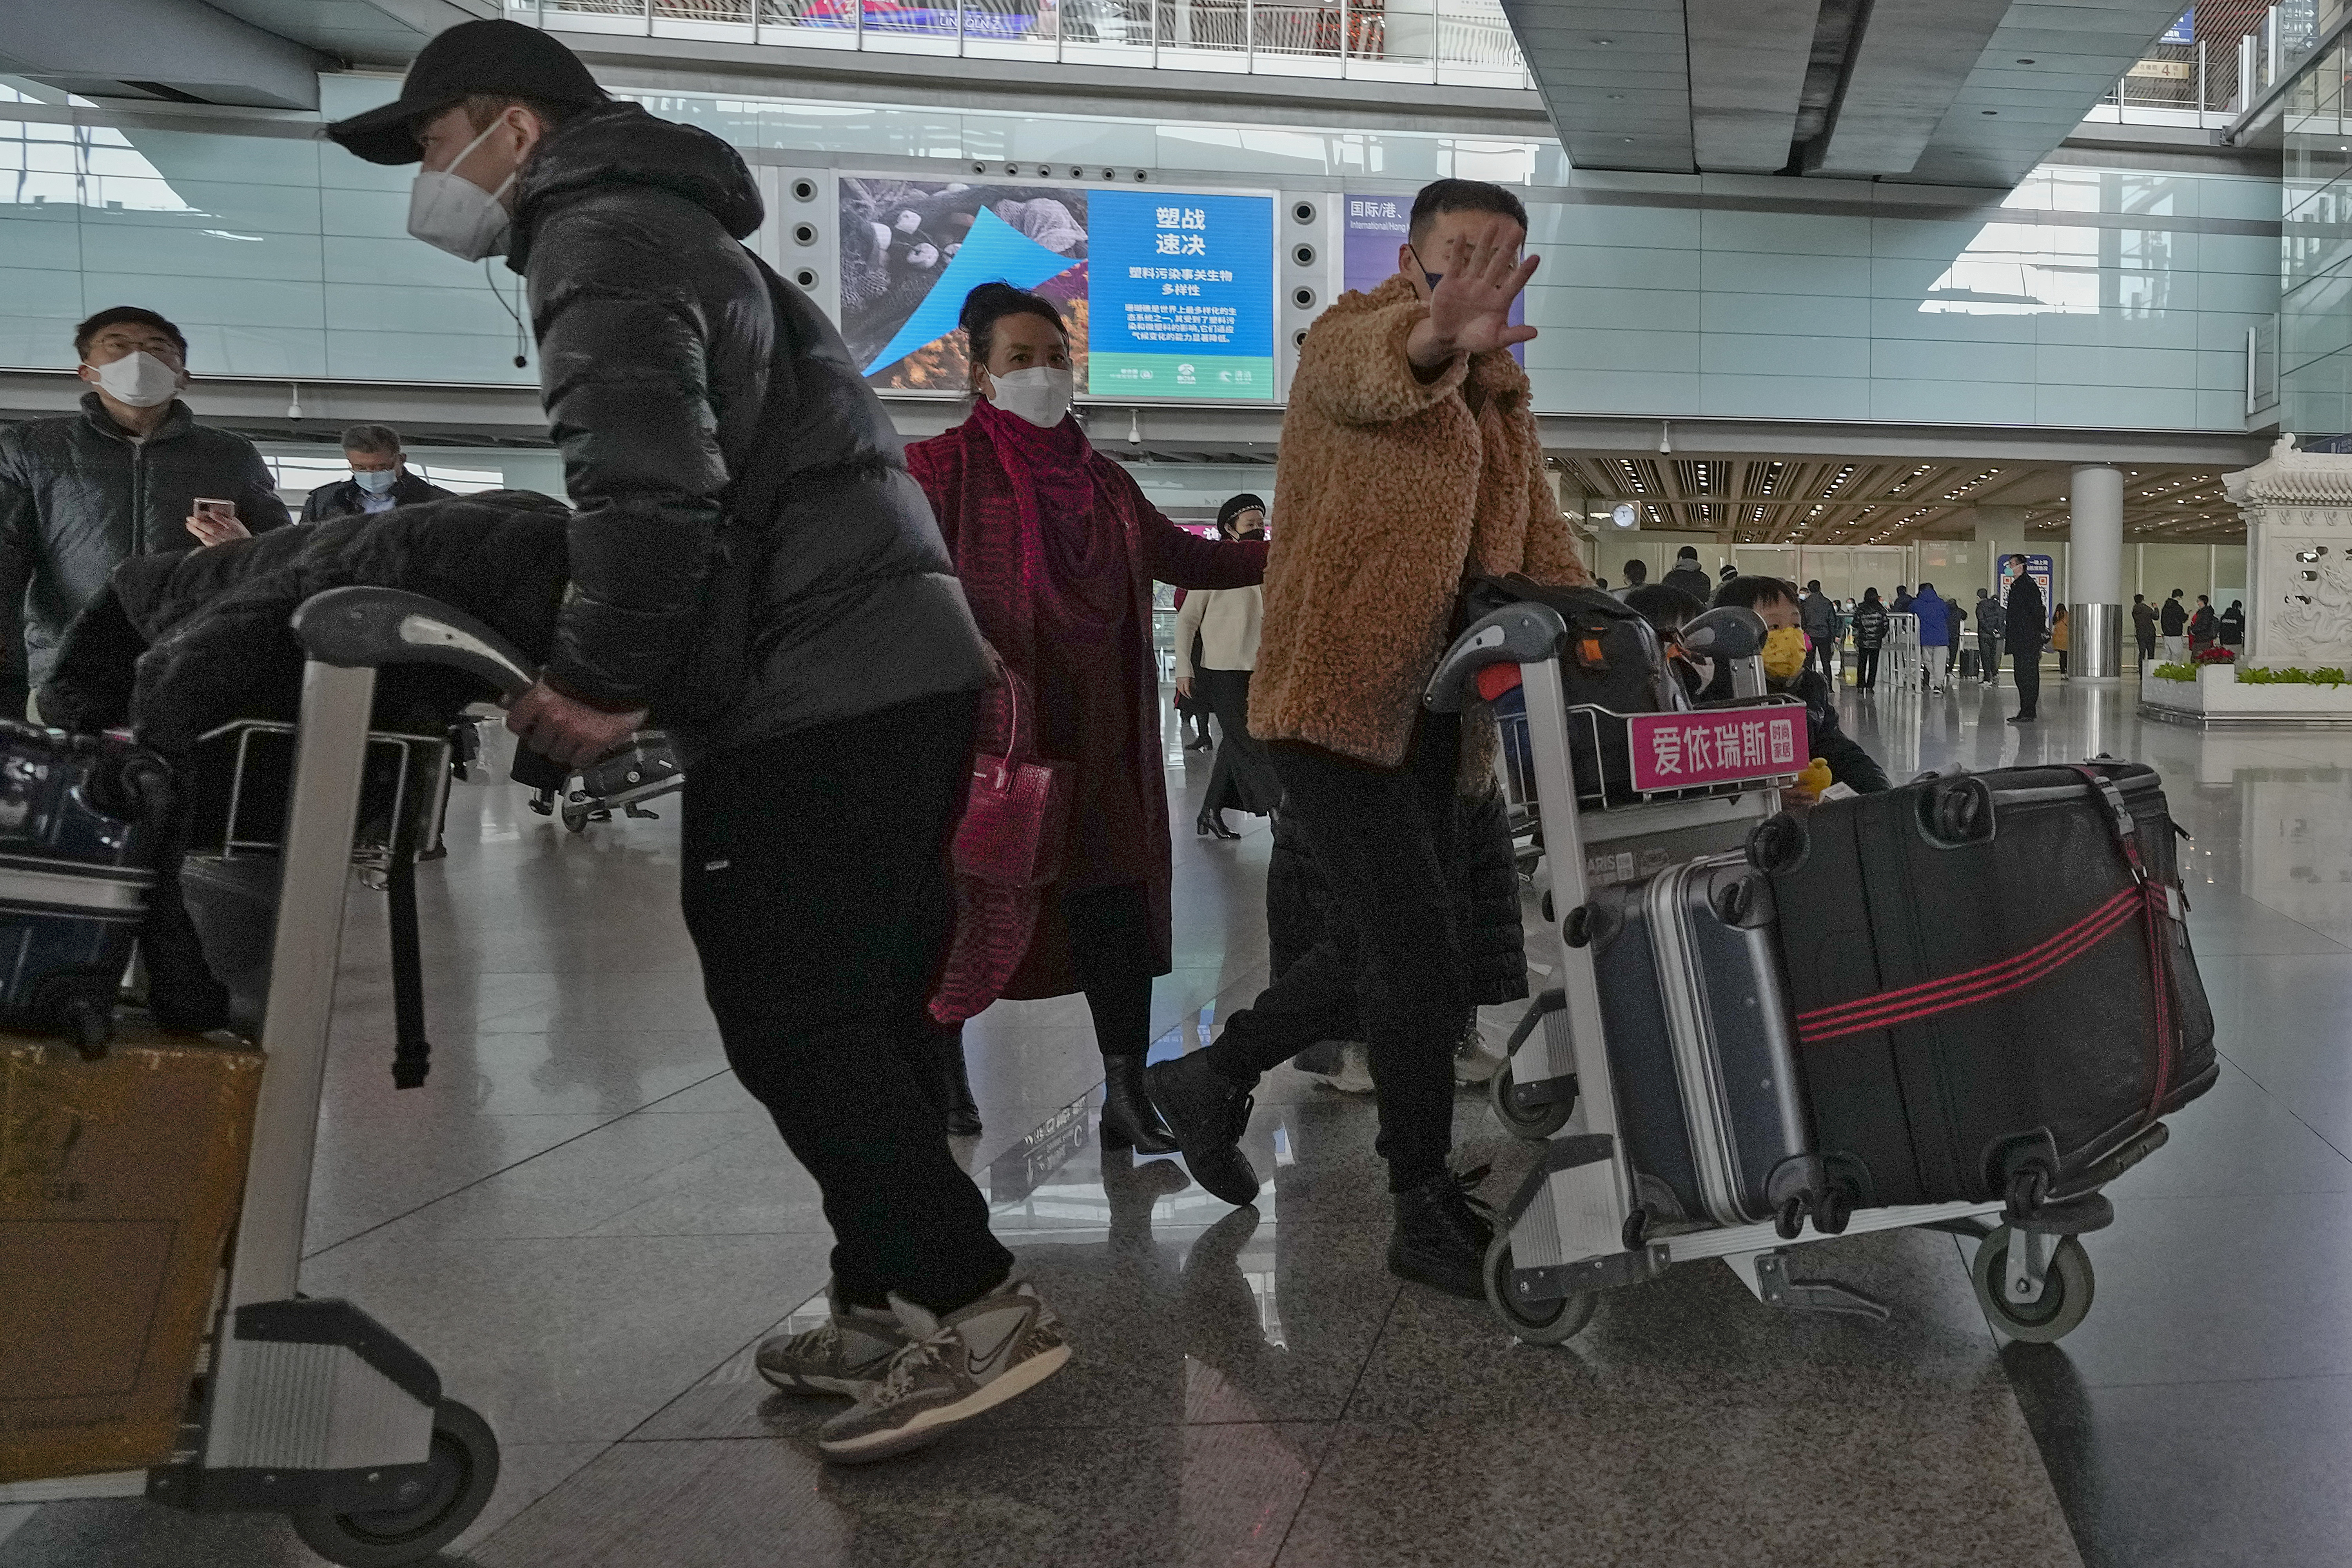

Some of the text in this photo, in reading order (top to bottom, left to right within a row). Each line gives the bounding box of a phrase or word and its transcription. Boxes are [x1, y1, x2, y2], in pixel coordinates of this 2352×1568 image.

[939, 14, 989, 29] LINOLN
[2161, 64, 2171, 76] 4
[1351, 200, 1402, 219] 国际/港、
[1156, 207, 1206, 230] 塑战
[1350, 220, 1406, 233] International/Hong
[1156, 234, 1206, 256] 速决
[1129, 267, 1233, 282] 塑料污染事关生物
[1161, 284, 1201, 296] 多样性
[1652, 721, 1766, 775] 爱依瑞斯
